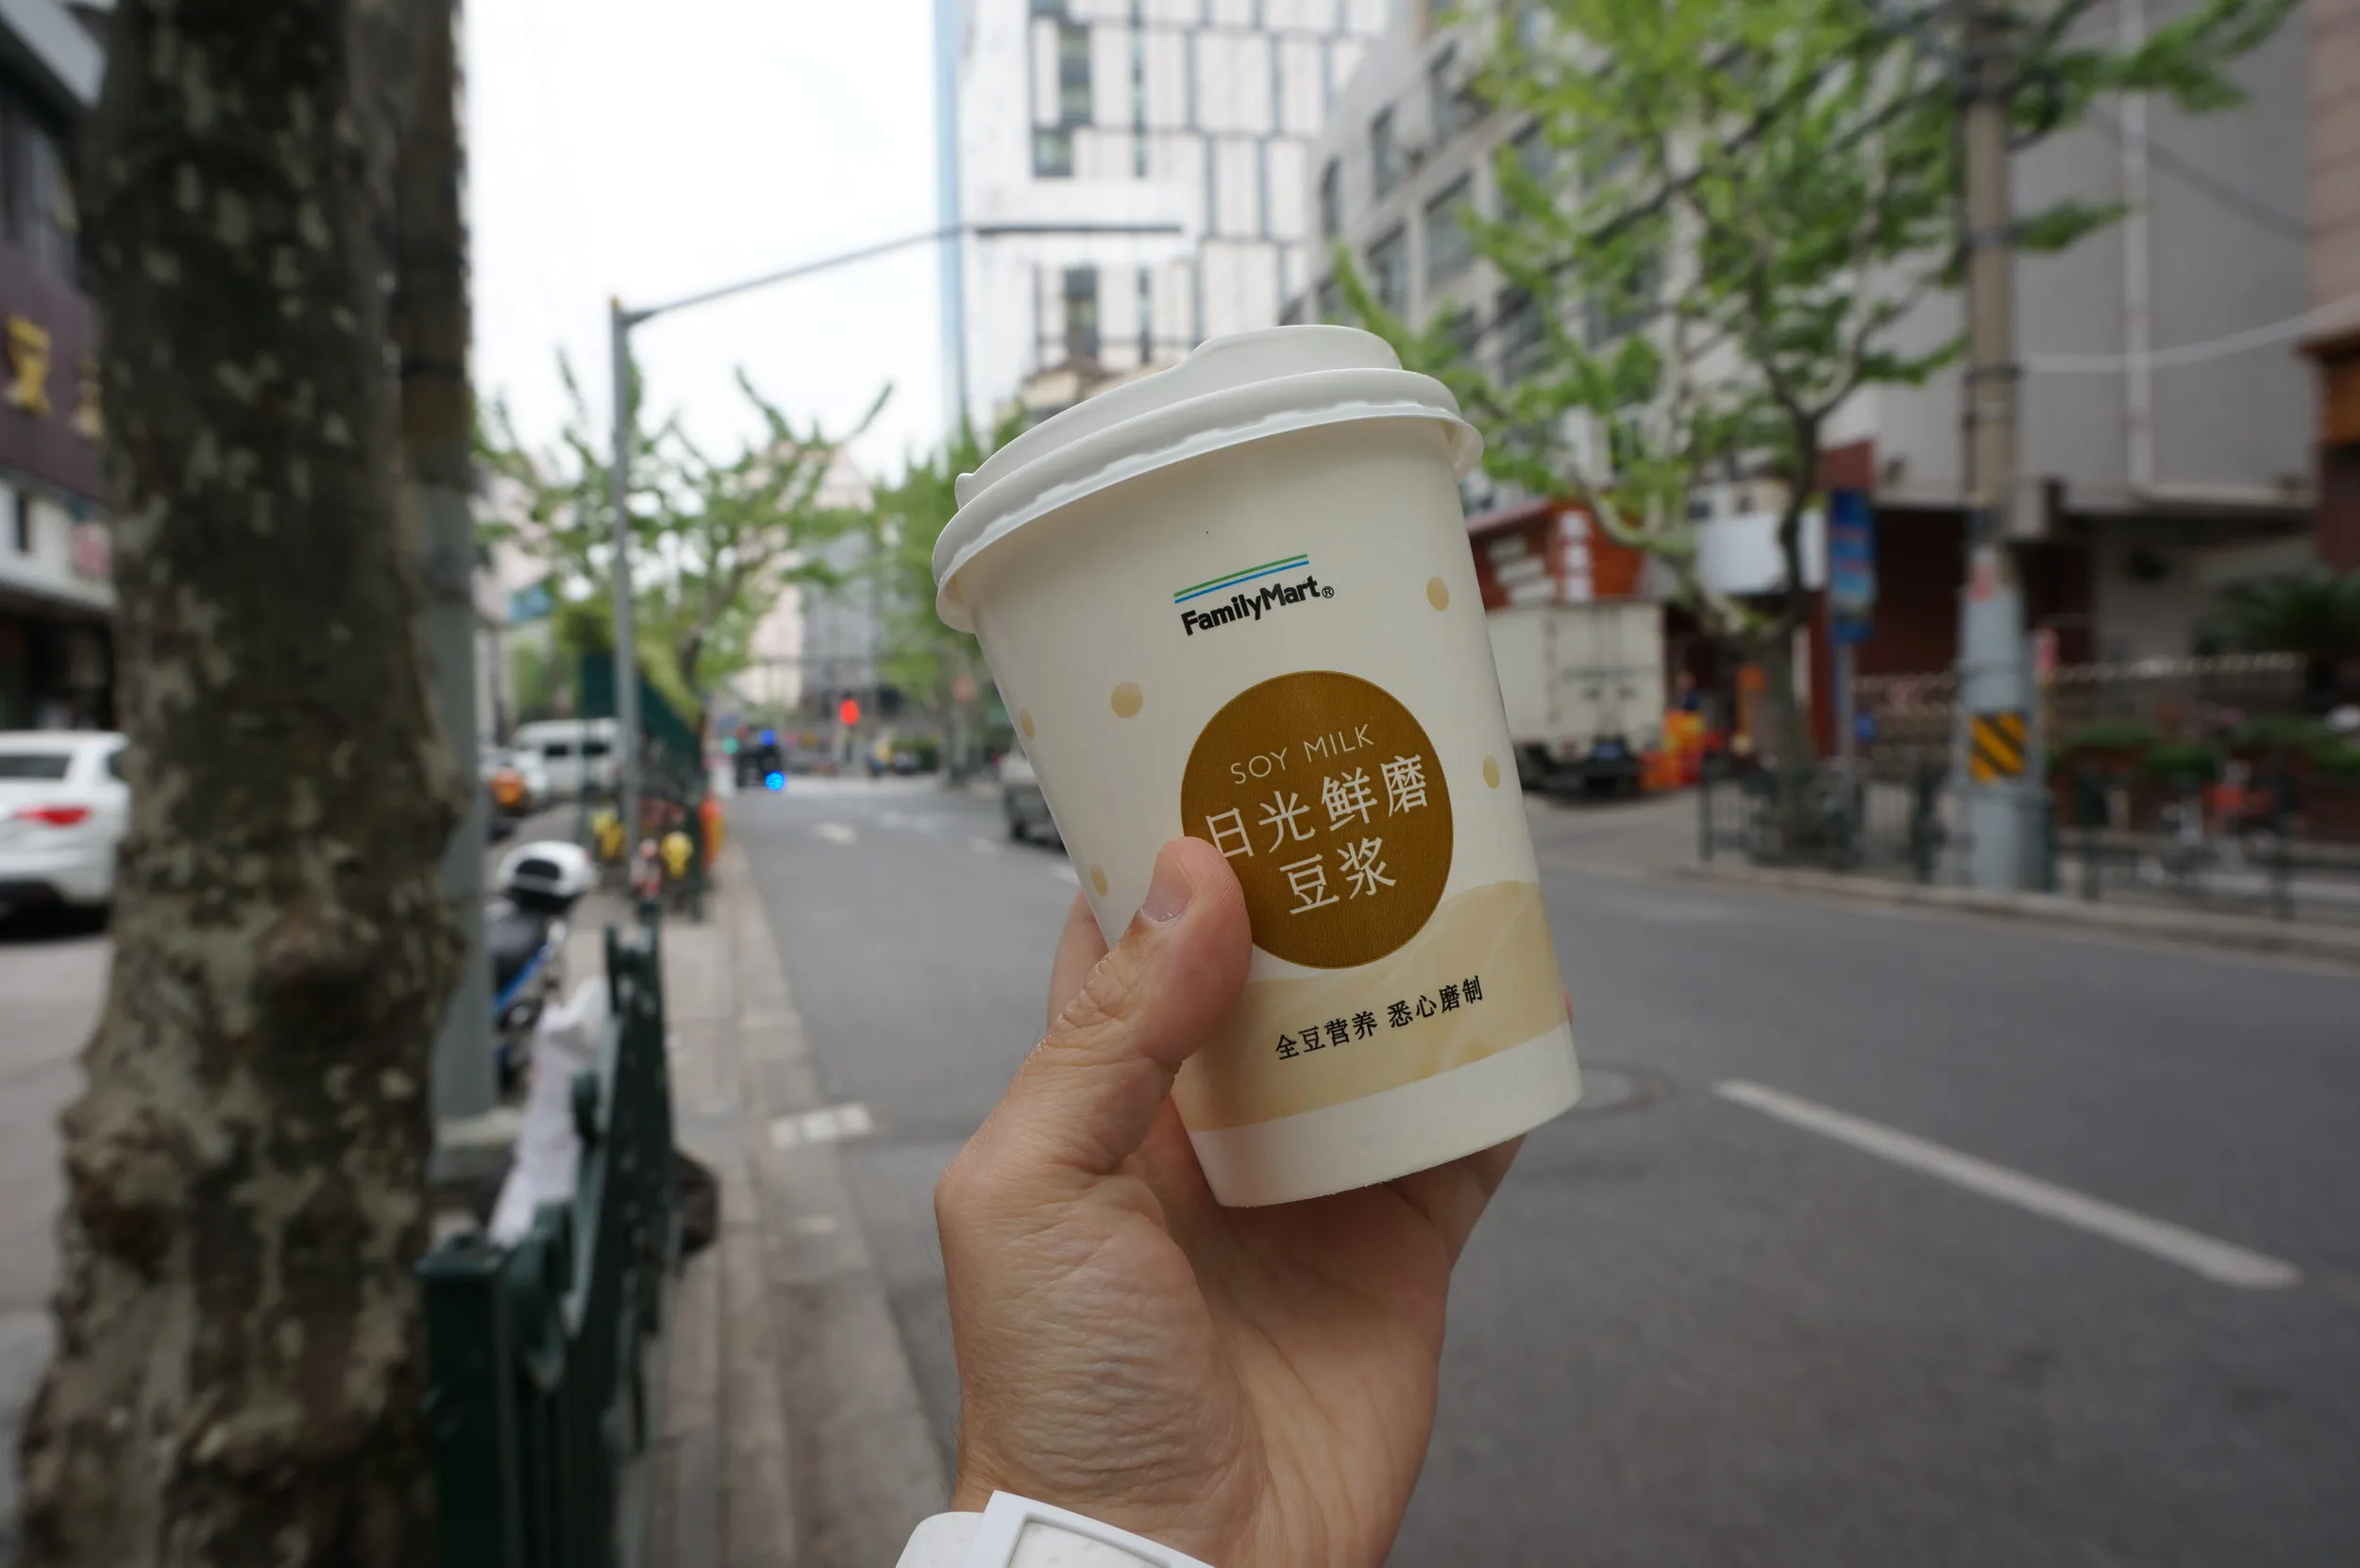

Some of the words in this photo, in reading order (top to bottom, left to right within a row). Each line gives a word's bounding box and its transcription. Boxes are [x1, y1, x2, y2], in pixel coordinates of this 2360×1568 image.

[1230, 748, 1287, 784] SOY
[1303, 724, 1374, 762] MILK
[1205, 754, 1427, 857] 日光鲜磨
[1279, 837, 1396, 914] 豆浆
[1275, 1010, 1377, 1060] 全豆营养
[1387, 975, 1483, 1028] 悉心磨制
